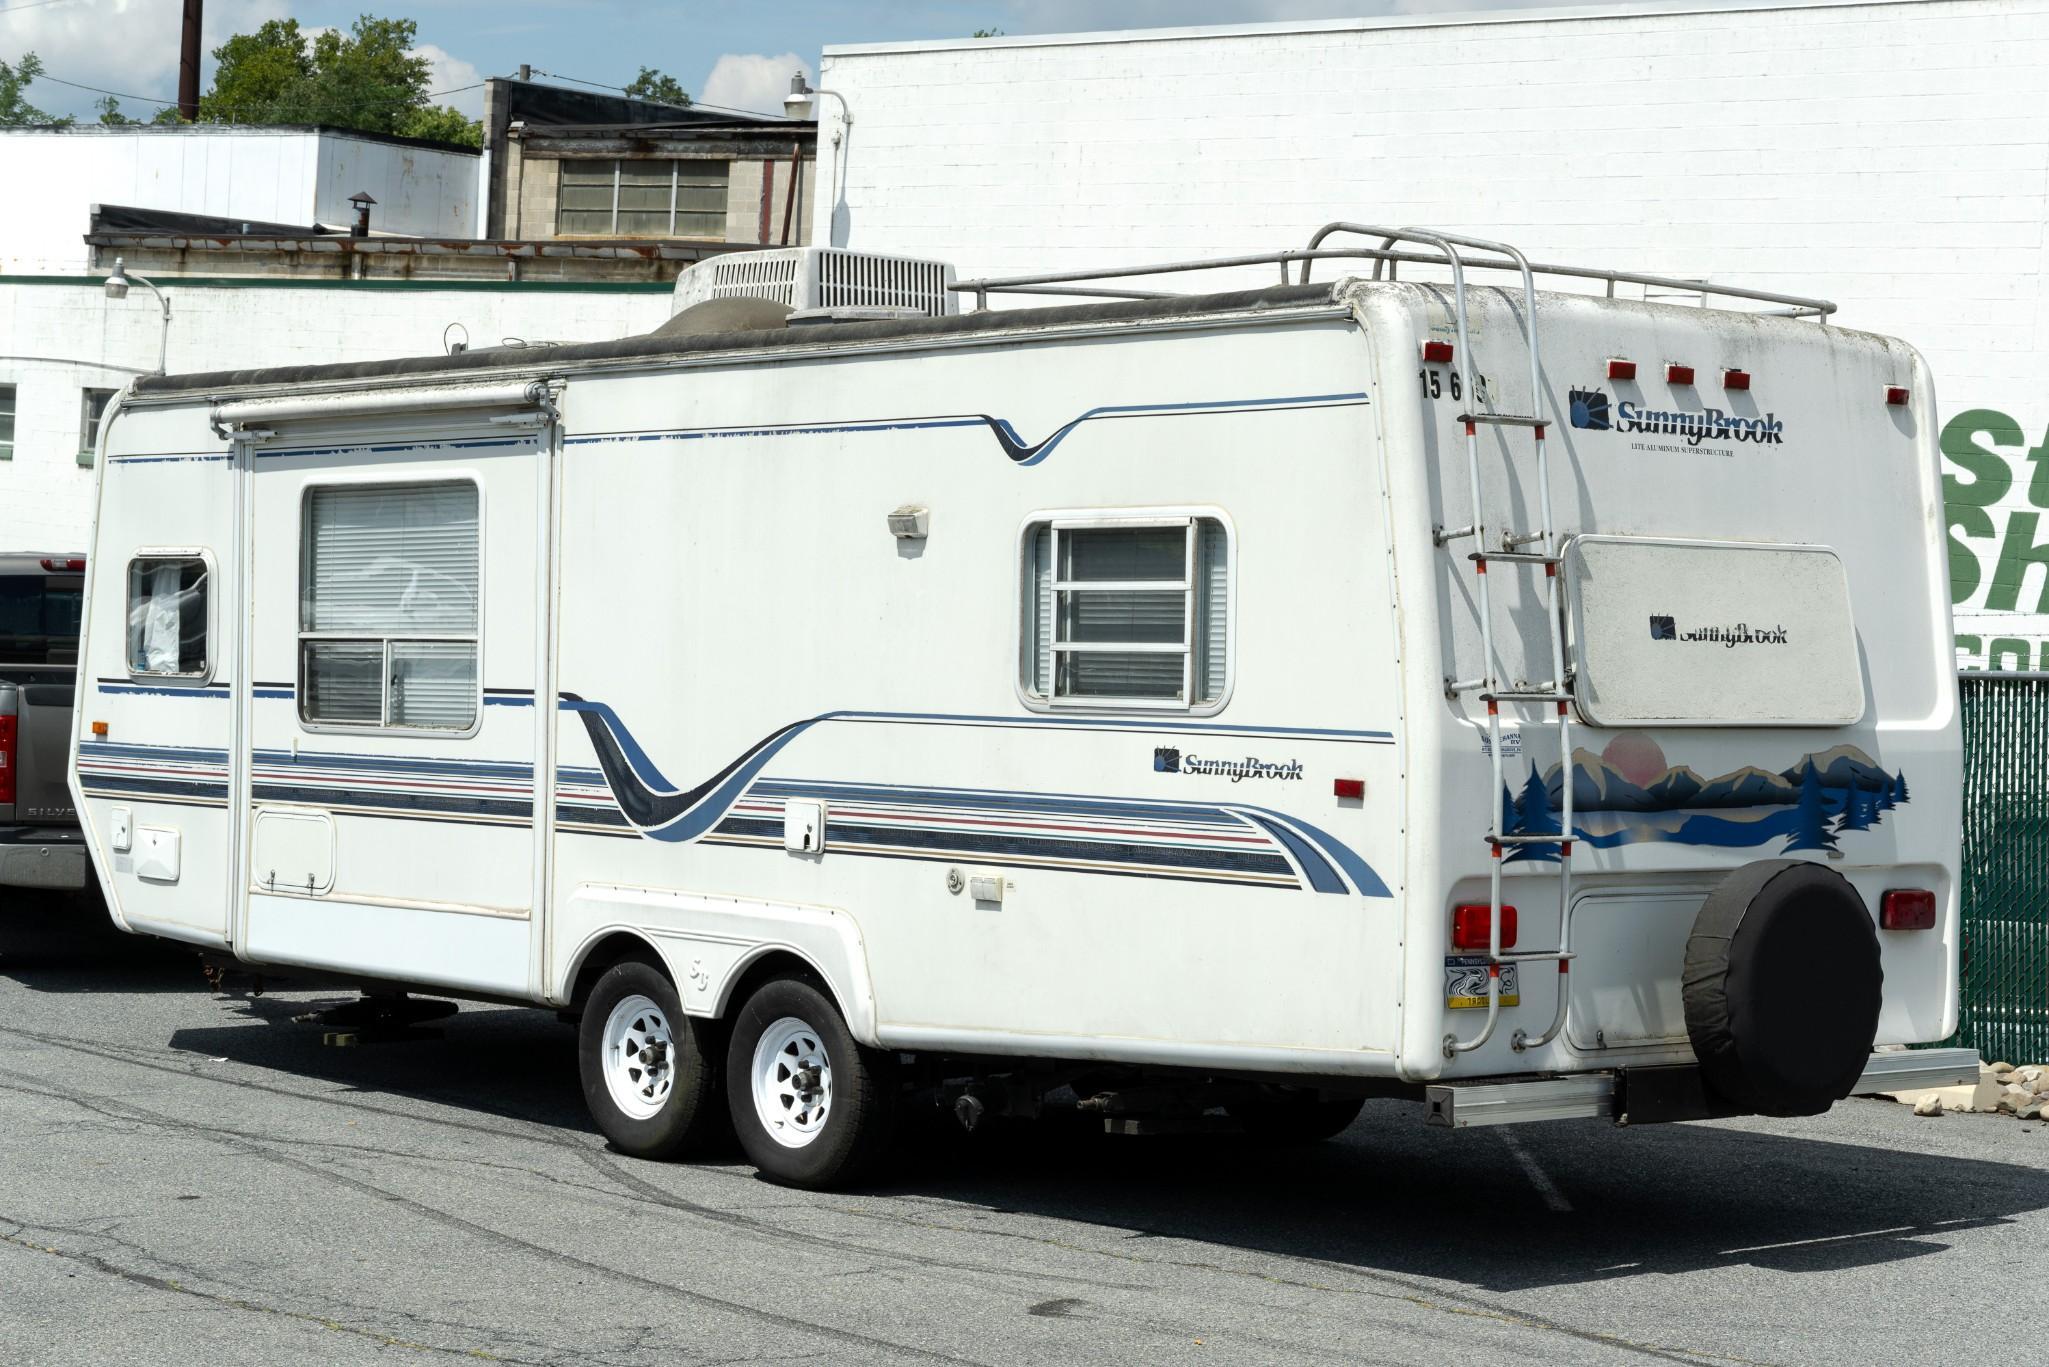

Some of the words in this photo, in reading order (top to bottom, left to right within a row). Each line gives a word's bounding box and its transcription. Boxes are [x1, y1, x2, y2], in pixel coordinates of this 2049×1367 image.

[1419, 368, 1441, 400] 15
[1617, 401, 1783, 446] SunnyBrook
[1646, 444, 1680, 453] ALUMINUM
[1681, 446, 1735, 457] SUPERSTRUCTURE
[1183, 754, 1303, 783] SunnyBrook
